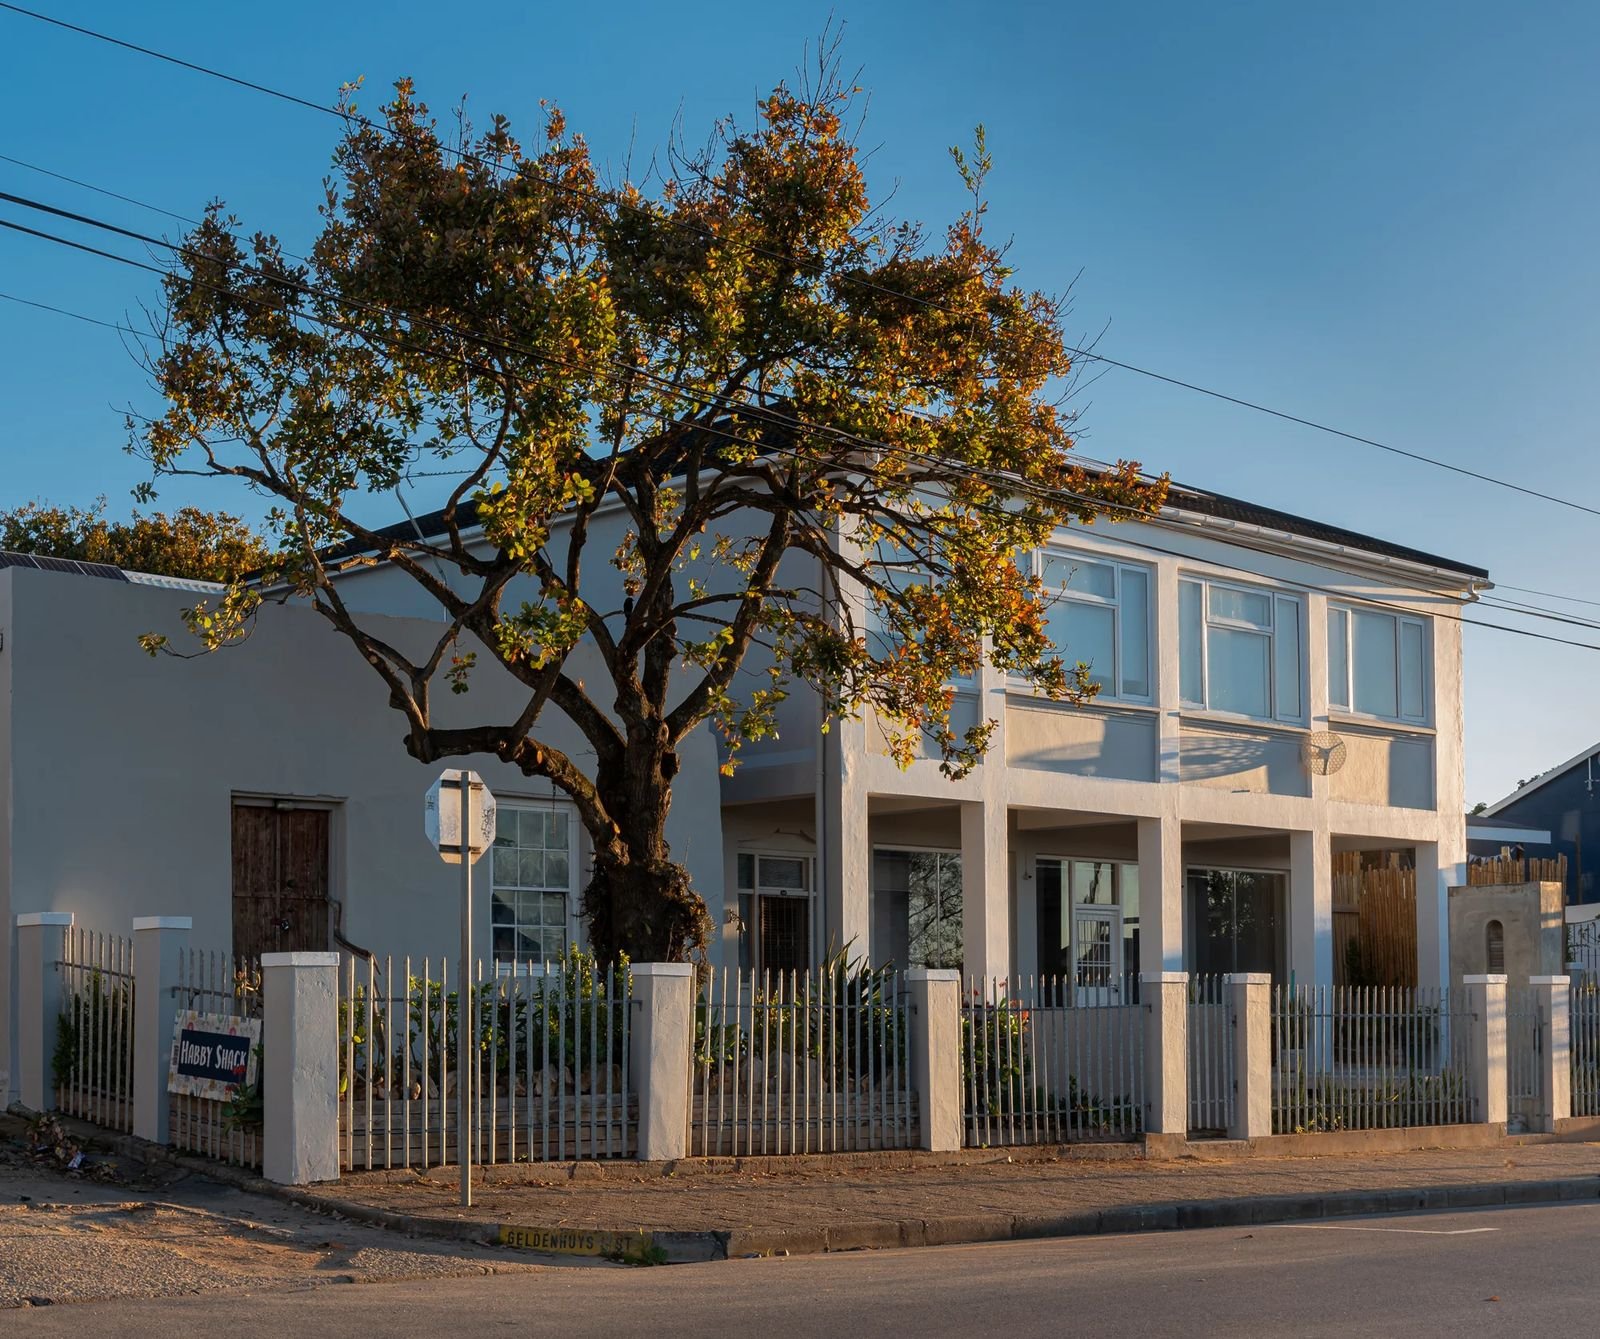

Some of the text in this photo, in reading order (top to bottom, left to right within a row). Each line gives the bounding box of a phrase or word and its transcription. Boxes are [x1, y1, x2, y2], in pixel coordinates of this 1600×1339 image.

[180, 1040, 247, 1070] HABBY SHACK
[507, 1231, 633, 1251] GELDENHUYS ST
